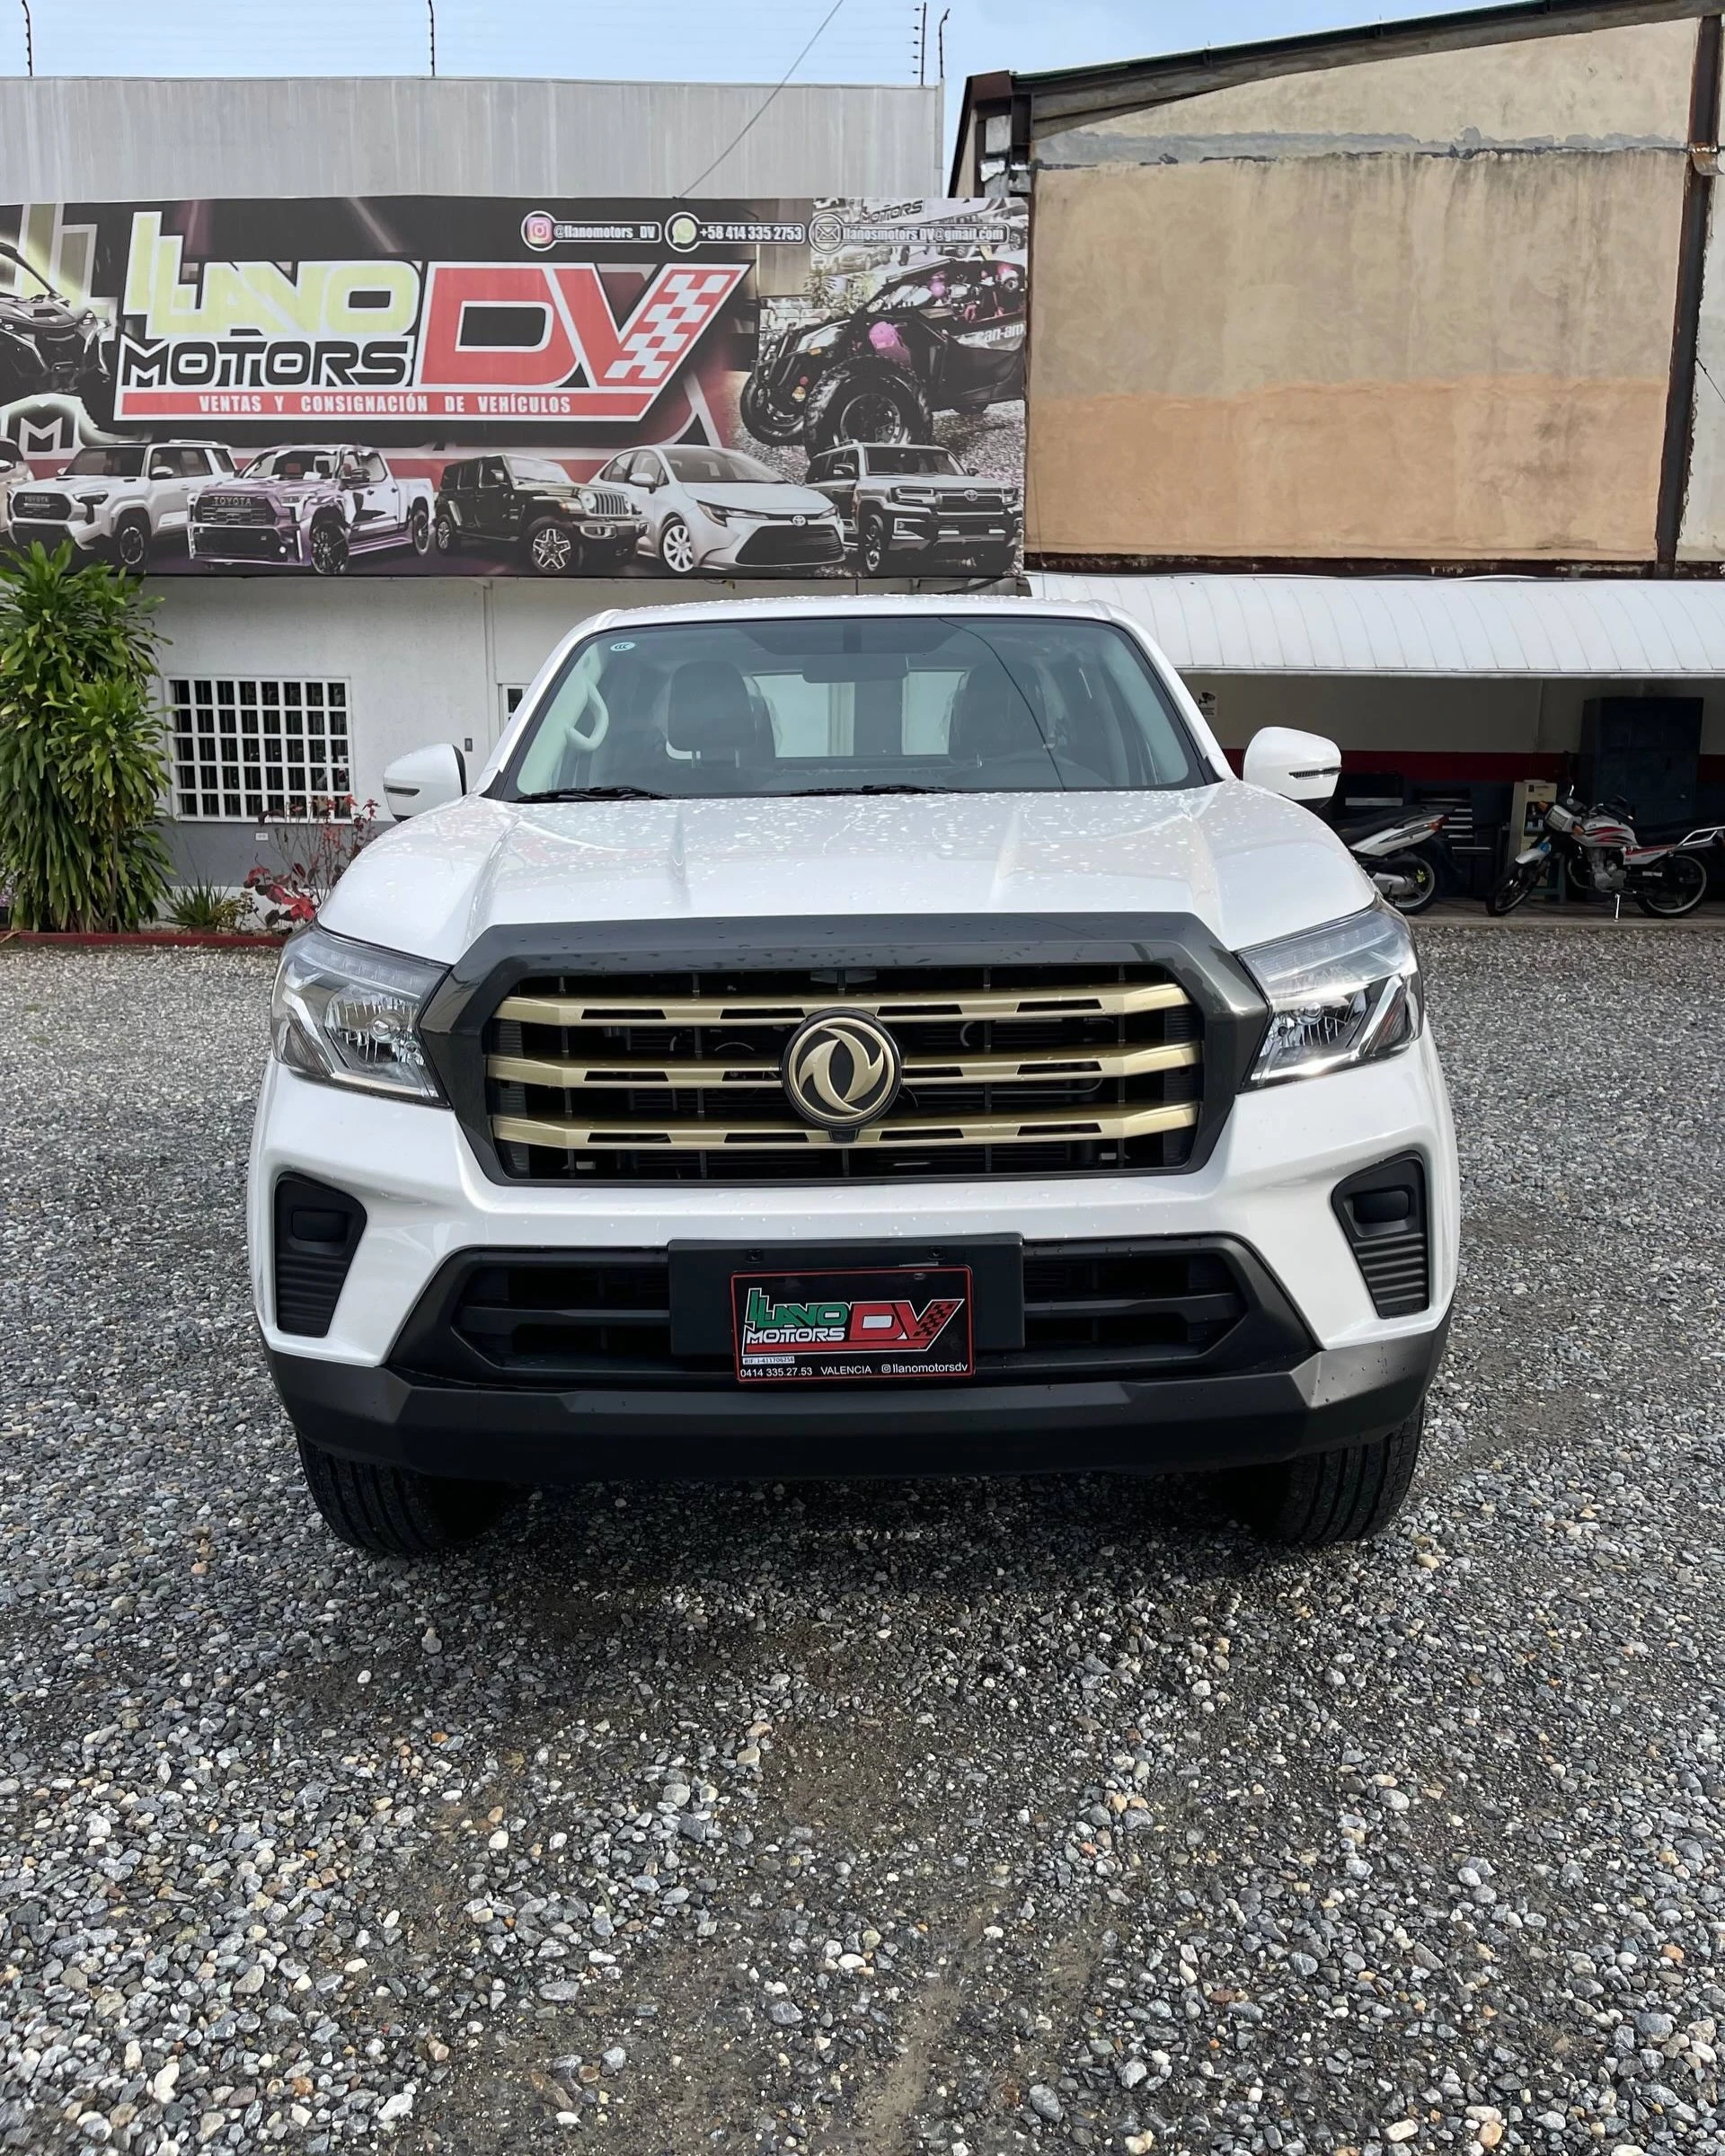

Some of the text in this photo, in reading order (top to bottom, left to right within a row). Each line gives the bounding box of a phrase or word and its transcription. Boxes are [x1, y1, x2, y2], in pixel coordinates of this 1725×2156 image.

[554, 225, 656, 240] @llanomotors_DV
[700, 225, 802, 240] +58 414 335 2753
[126, 213, 420, 336] LLANO
[421, 267, 748, 387] DV
[121, 339, 411, 387] MOTORS
[199, 393, 571, 413] VENTAS Y CONSIGNACIÓN DE VEHÍCULOS
[214, 496, 252, 507] TOYOTA
[748, 1290, 960, 1341] LLANO DV
[746, 1325, 845, 1345] MOTORS
[739, 1368, 764, 1378] 0414
[765, 1366, 813, 1377] 335.27.53
[820, 1365, 872, 1375] VALENCIA
